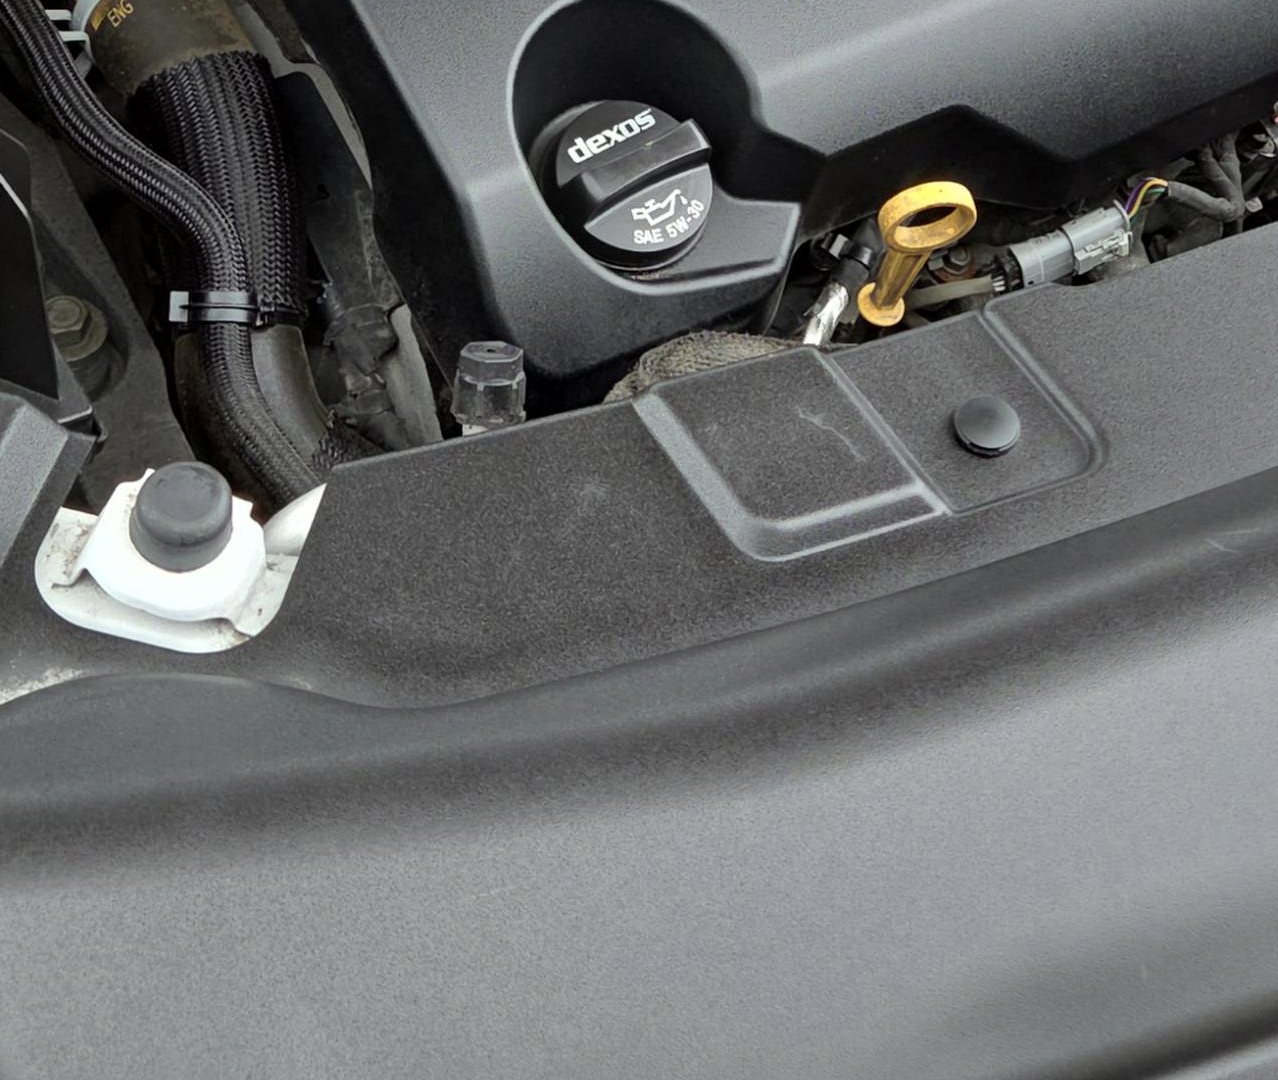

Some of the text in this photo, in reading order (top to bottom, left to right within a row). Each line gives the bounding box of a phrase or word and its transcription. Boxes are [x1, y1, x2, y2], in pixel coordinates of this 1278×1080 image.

[566, 107, 657, 164] dexos
[633, 199, 705, 245] SAE 5W-30
